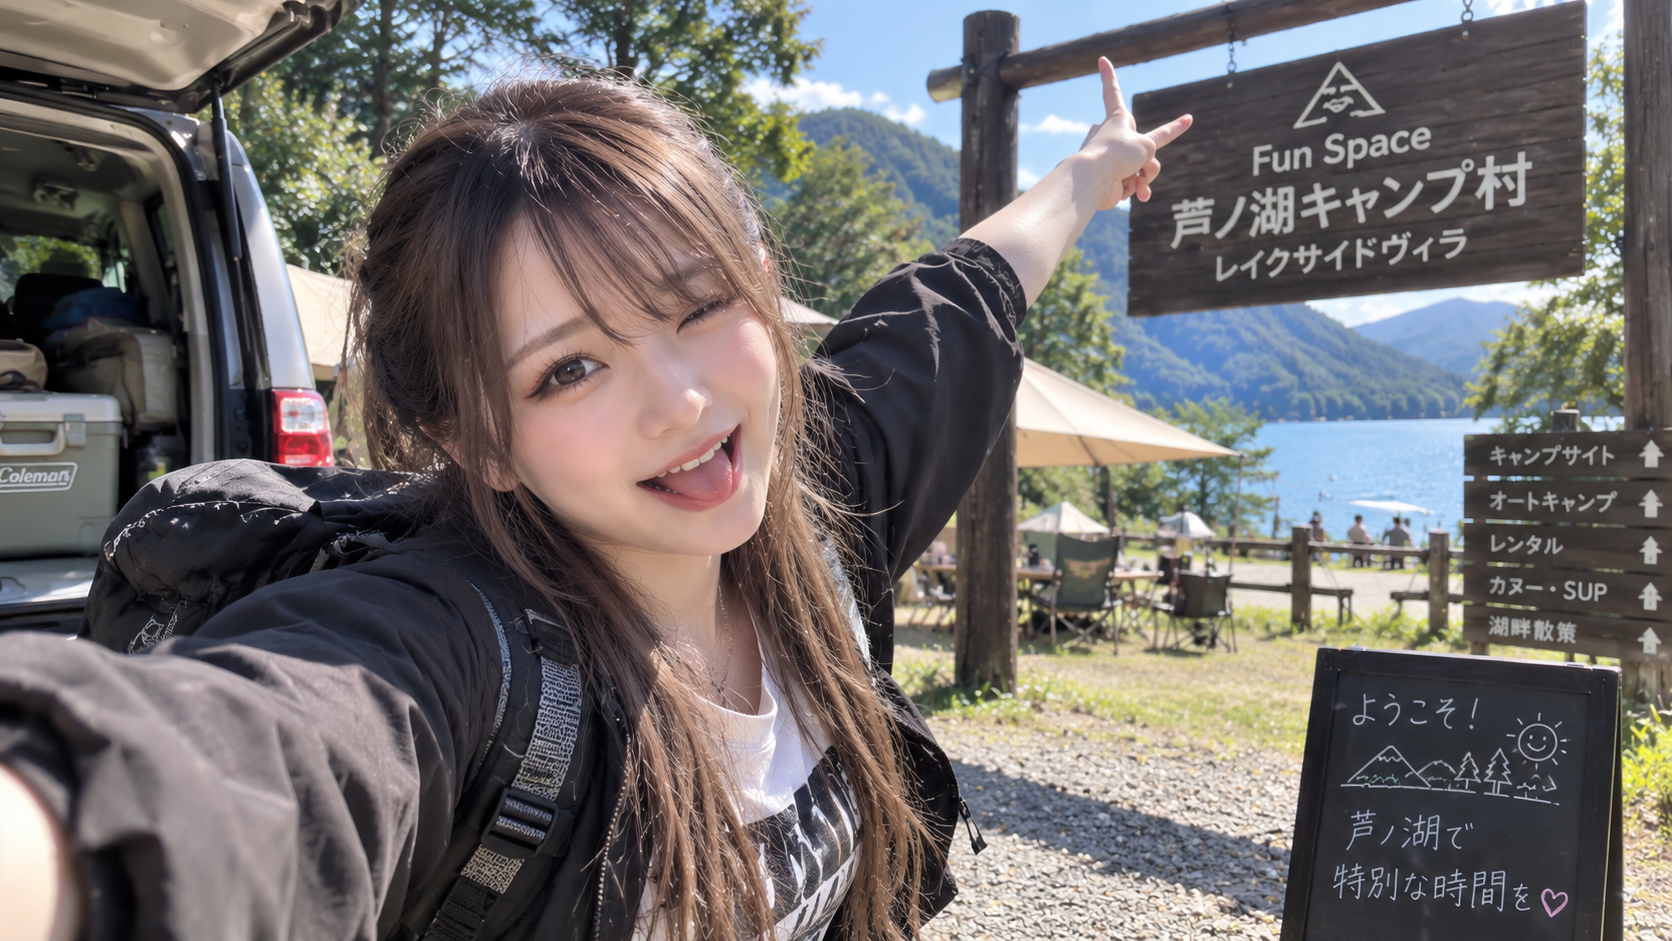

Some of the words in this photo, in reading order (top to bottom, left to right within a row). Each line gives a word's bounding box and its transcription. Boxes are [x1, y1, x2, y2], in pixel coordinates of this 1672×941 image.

[1252, 144, 1313, 176] Fun
[1323, 126, 1432, 168] Space
[1170, 150, 1533, 249] 芦ノ湖キャンプ村
[1215, 228, 1467, 282] レイクサイドヴィラ
[1489, 444, 1614, 466] キャンプサイト
[1489, 490, 1618, 513] オートキャンプ
[1490, 534, 1564, 555] レンタル
[1489, 576, 1608, 602] カヌー・SUP
[1488, 615, 1577, 644] 湖畔散策
[1346, 809, 1475, 851] 芦ノ湖で
[1333, 862, 1531, 912] 特別な時間を
